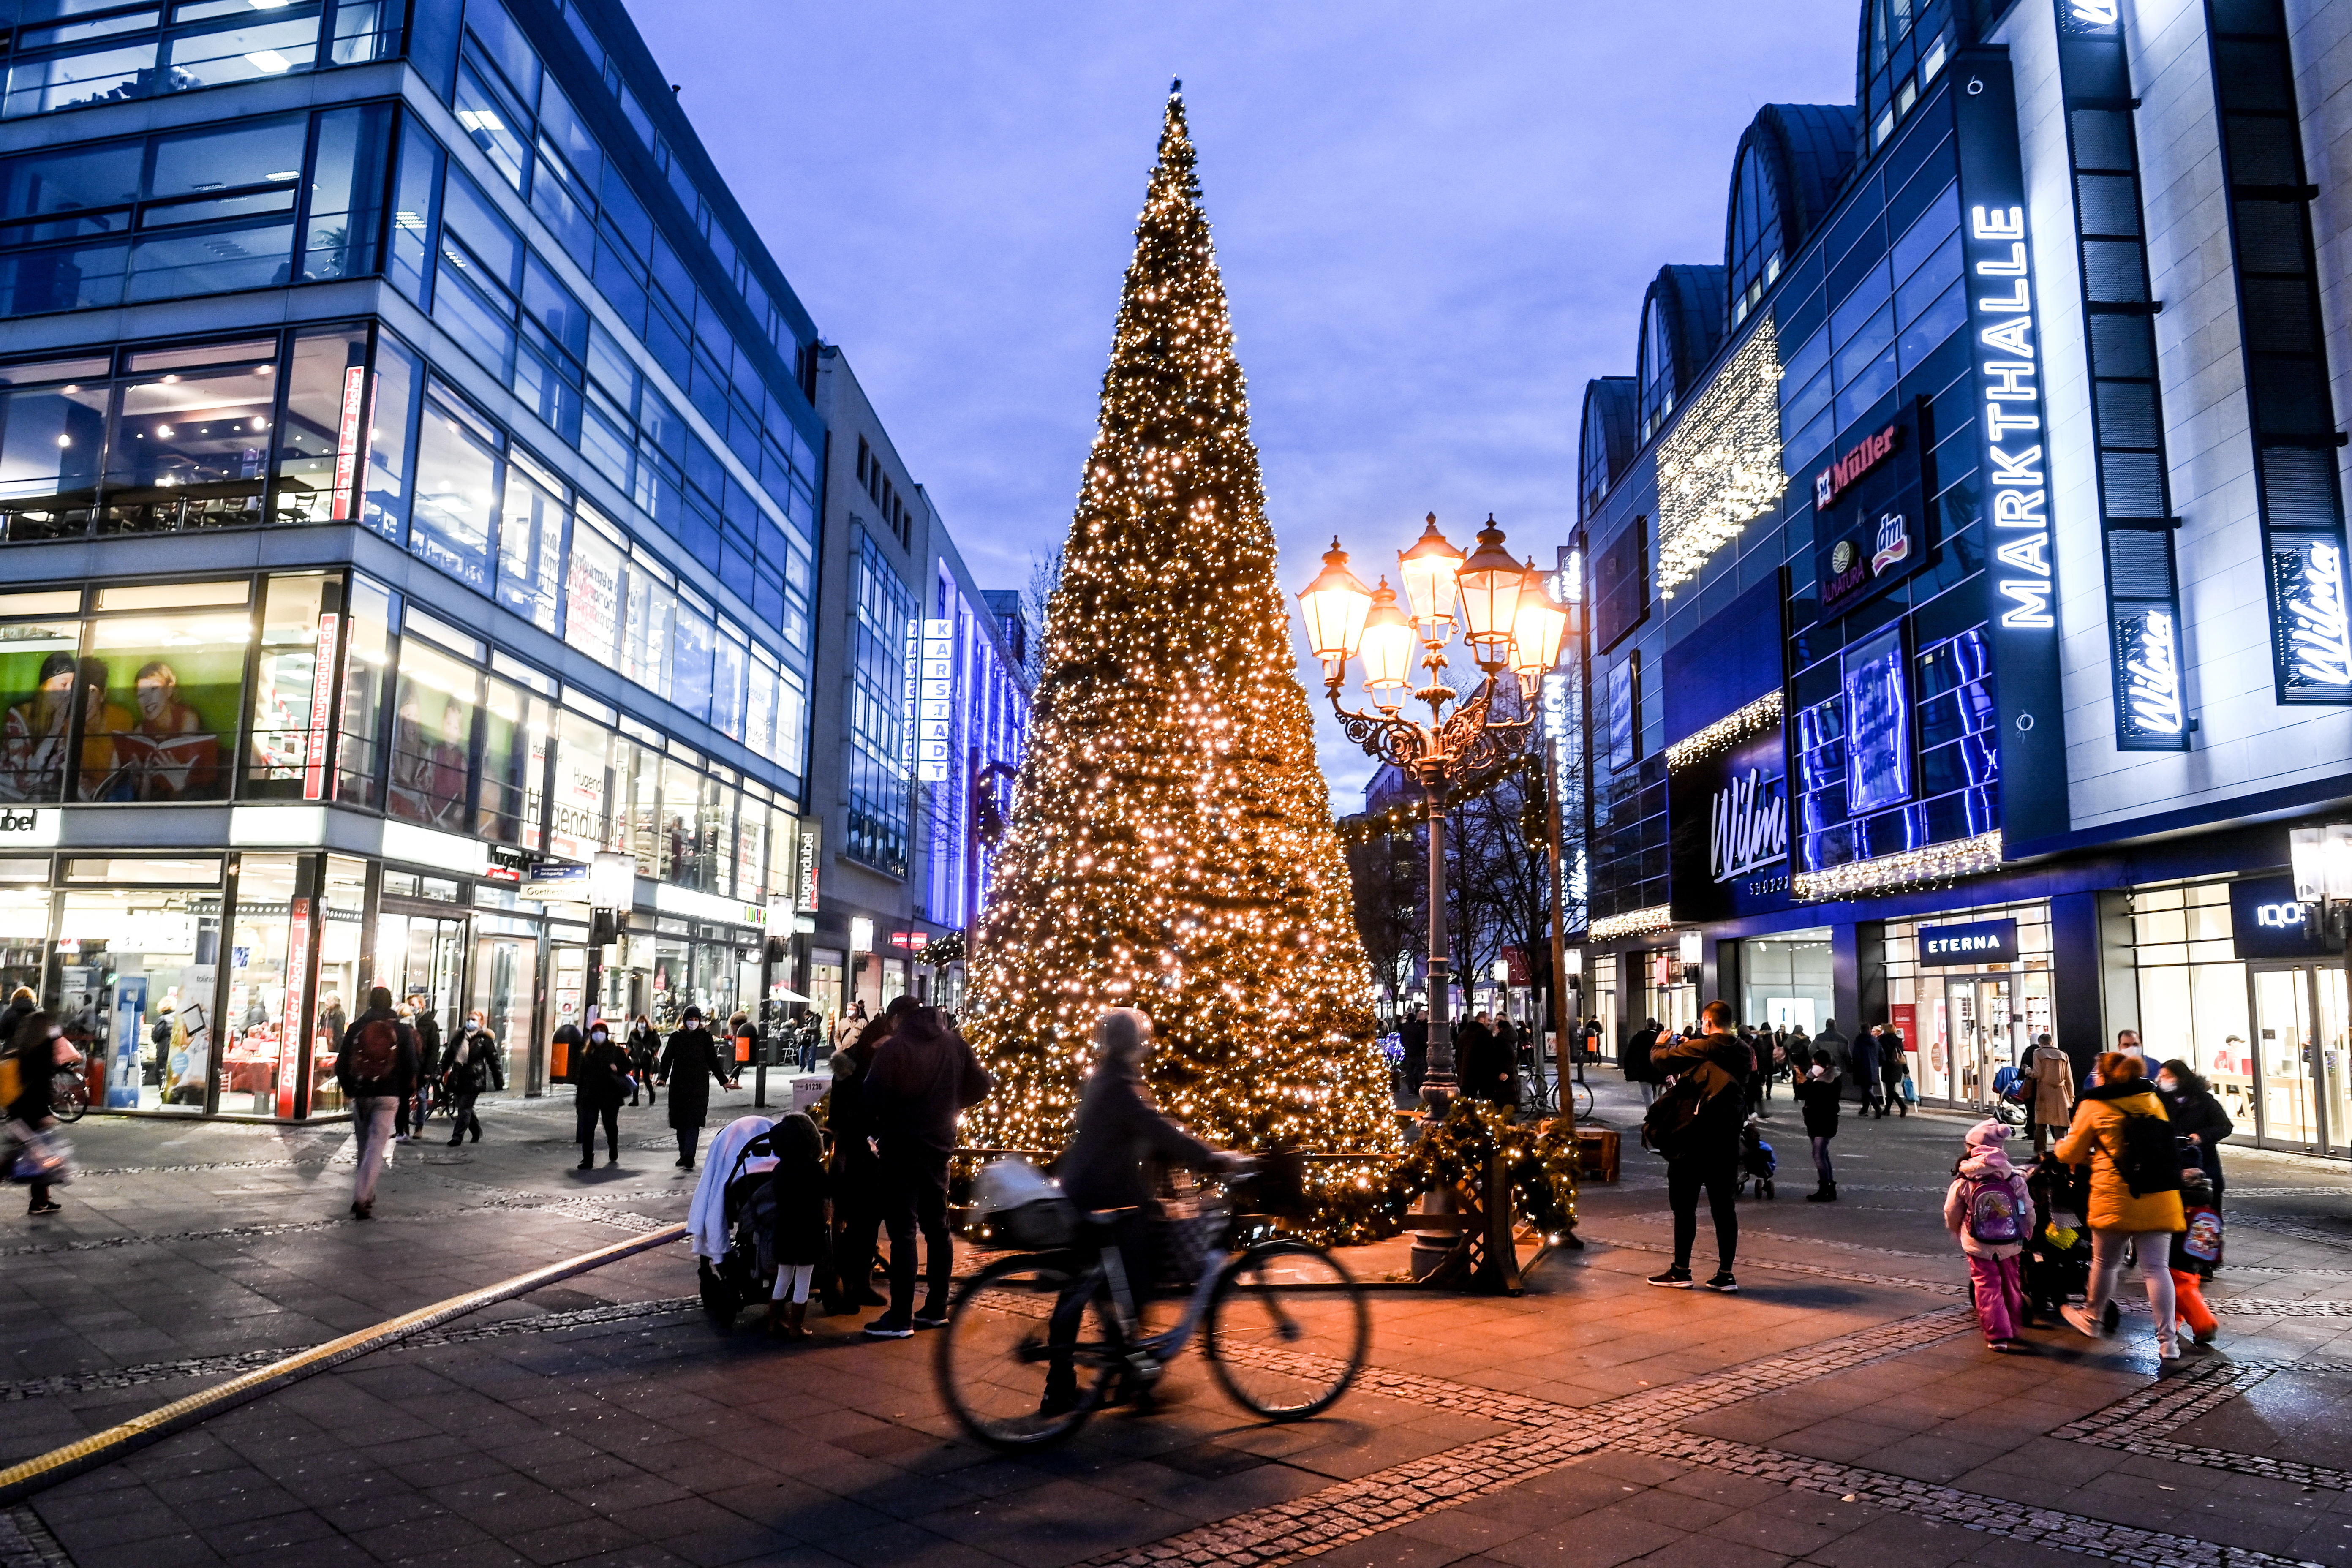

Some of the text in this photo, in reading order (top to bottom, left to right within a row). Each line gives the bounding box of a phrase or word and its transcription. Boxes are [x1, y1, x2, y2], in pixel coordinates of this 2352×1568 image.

[345, 371, 360, 415] Bücher
[342, 419, 355, 441] der
[1972, 206, 2054, 629] MARKTHALLE
[1833, 425, 1896, 494] Müller
[336, 475, 349, 500] Die
[1878, 514, 1903, 552] dm
[2289, 541, 2352, 685] Wilma
[311, 623, 333, 759] www.hugendubel.de
[2127, 610, 2181, 734] Wilma
[932, 623, 949, 778] KARSTADT
[527, 886, 578, 898] Goethestraß
[798, 833, 814, 911] Hugendubel
[1928, 934, 2001, 954] ETERNA
[289, 944, 304, 994] Bücher
[287, 1000, 299, 1020] der
[284, 1026, 297, 1058] Welt
[281, 1059, 294, 1087] Die
